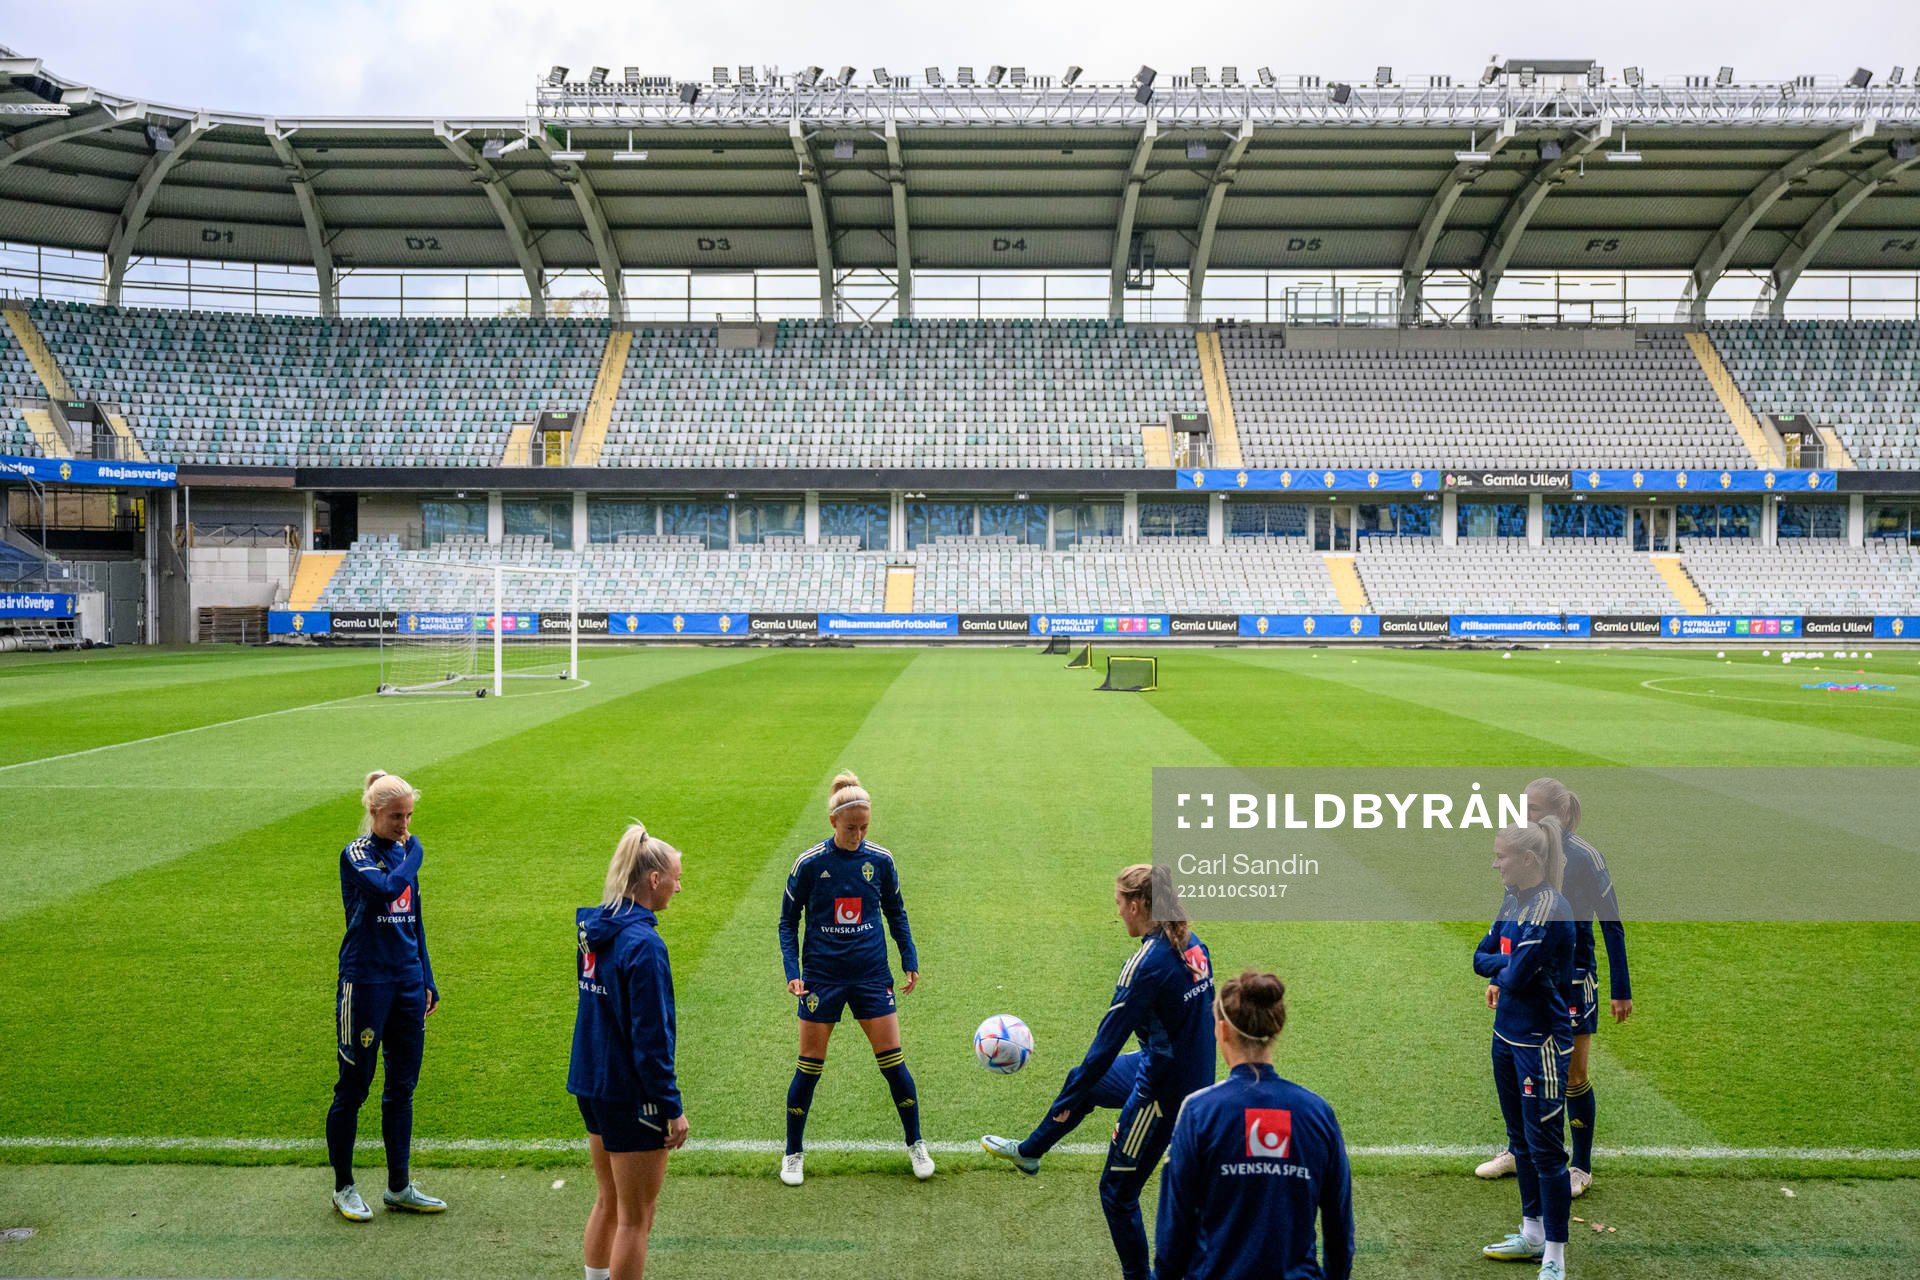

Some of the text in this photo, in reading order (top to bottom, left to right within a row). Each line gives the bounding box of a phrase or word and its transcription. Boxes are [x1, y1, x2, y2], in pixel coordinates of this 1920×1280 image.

[201, 227, 234, 243] D1
[404, 236, 442, 251] D2
[697, 237, 731, 252] D3
[992, 237, 1027, 252] D4
[1286, 238, 1322, 252] D5
[1584, 238, 1620, 252] F5
[1882, 238, 1918, 252] F4
[0, 462, 35, 475] verige
[98, 466, 176, 482] #hejasverige
[1482, 474, 1568, 486] Gamla Ullevi
[6, 595, 15, 609] är
[16, 595, 24, 609] vi
[25, 595, 54, 612] Sverige
[333, 618, 398, 628] Gamla Ulevi
[543, 619, 608, 629] Gaml Ullevi
[752, 619, 817, 629] Gamla Ullevi
[829, 619, 947, 630] #tillsammansförfotbollen
[962, 620, 1028, 630] Gamla Ullevi
[1171, 620, 1237, 631] Gamla Ullevi
[1383, 621, 1448, 631] Gamla Ullevi
[1461, 621, 1580, 632] #tillsammansförfotboen
[1594, 621, 1660, 631] Gamla Ullevi
[1807, 622, 1872, 632] Gamla Ullevi
[376, 915, 406, 923] SVENSKA
[821, 922, 874, 934] SVENSKA SPEL
[1220, 1160, 1311, 1180] SVENSKA SPEL
